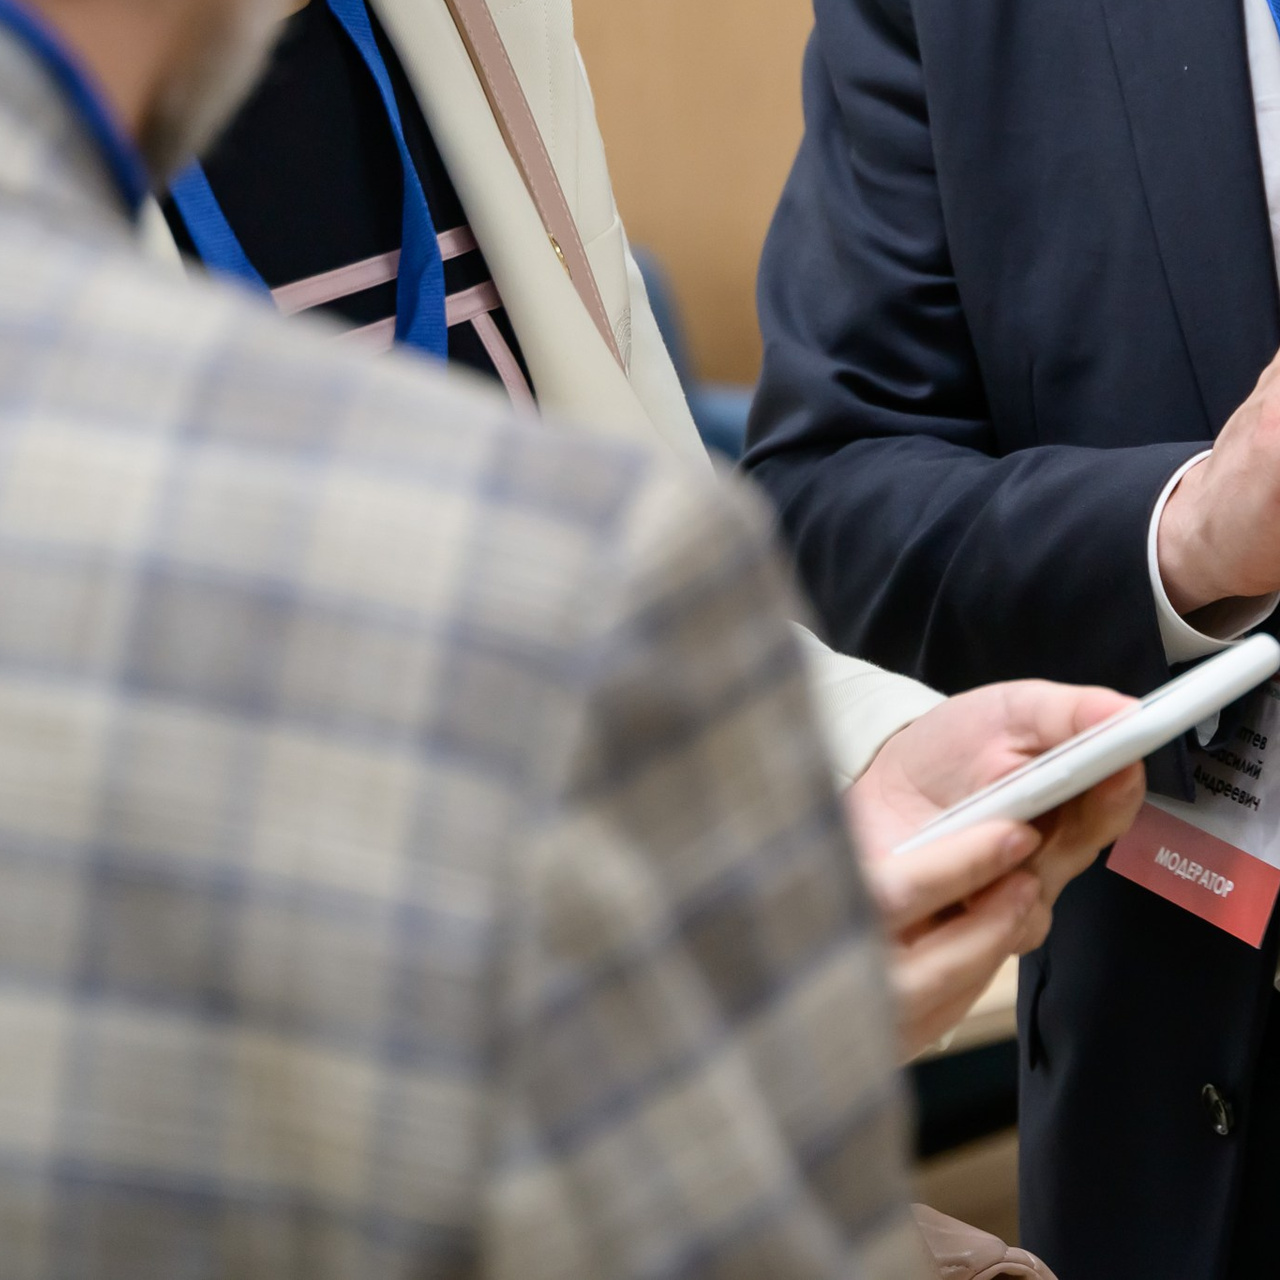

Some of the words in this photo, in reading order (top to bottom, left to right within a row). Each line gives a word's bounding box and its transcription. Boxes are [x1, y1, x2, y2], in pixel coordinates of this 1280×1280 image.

[1238, 725, 1268, 750] птев
[1193, 764, 1261, 812] Андреевич
[1153, 845, 1236, 898] МОДЕРАТОР
